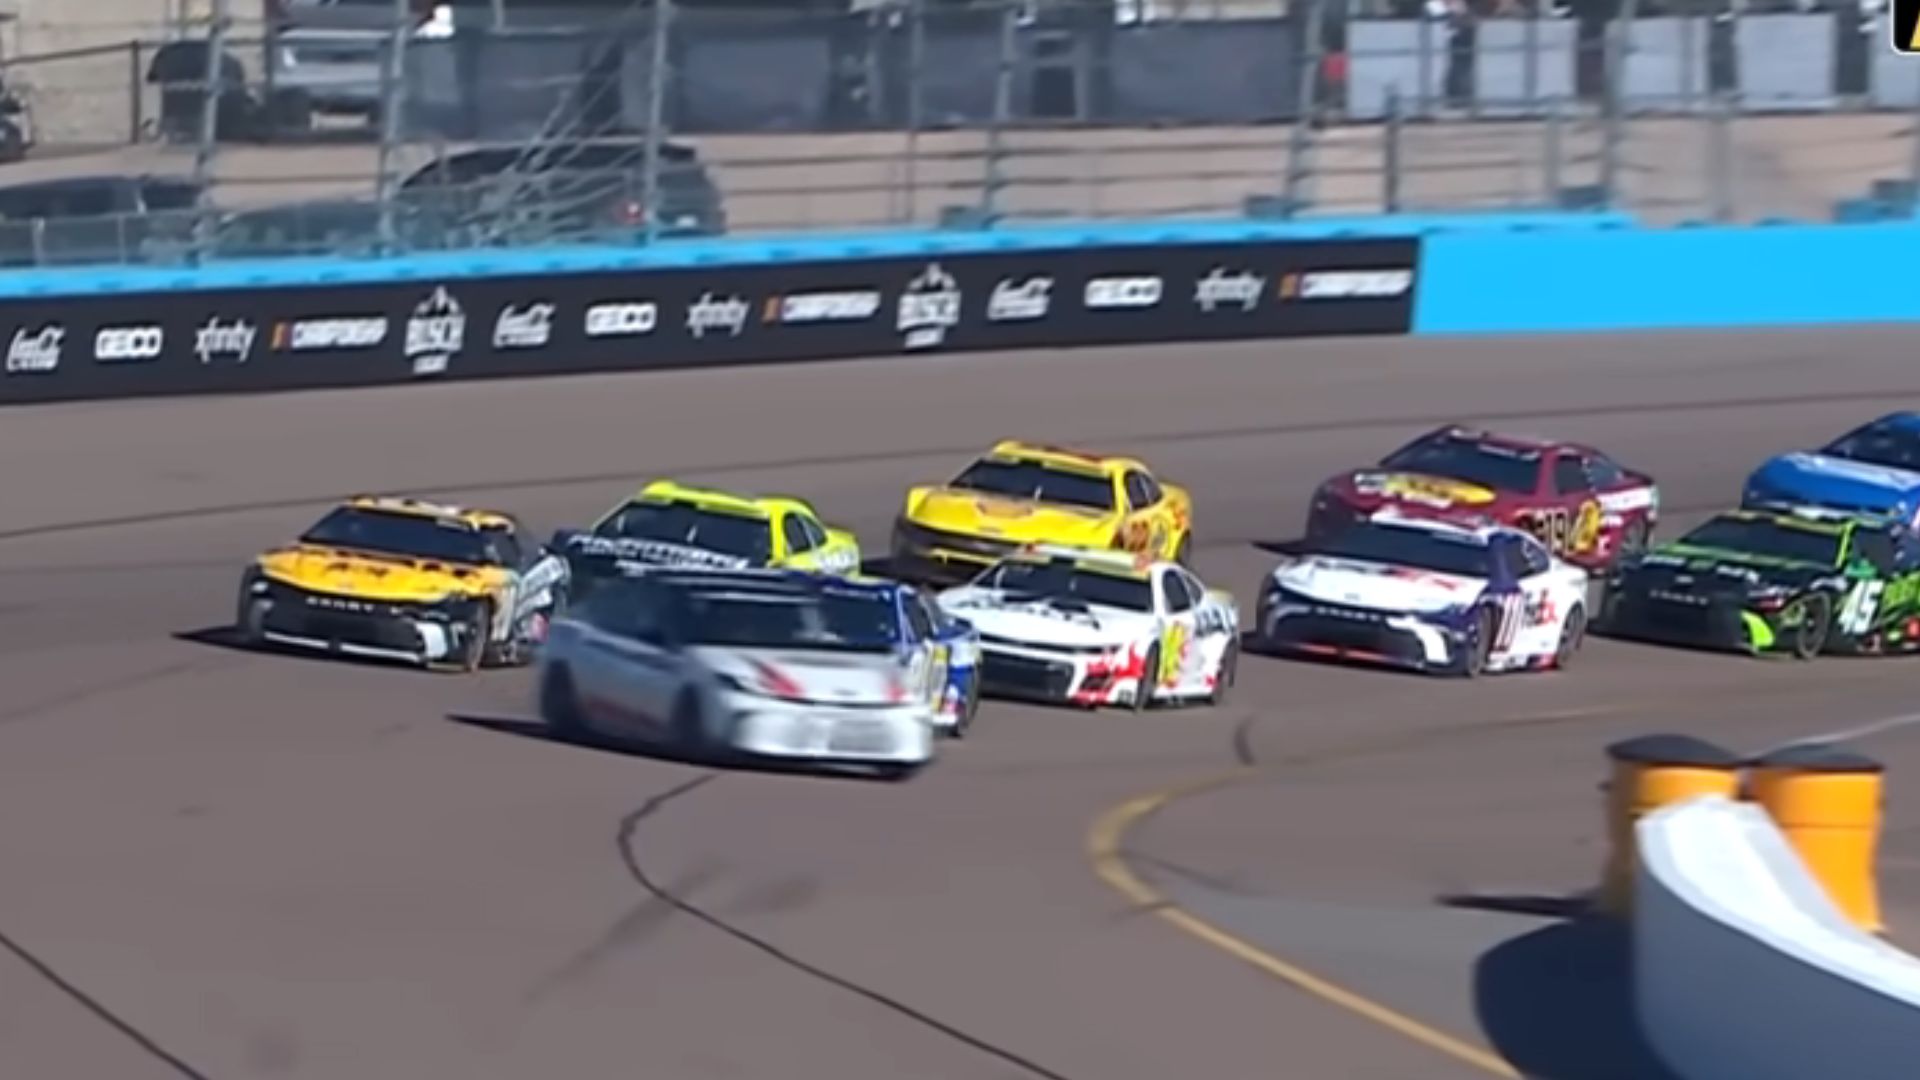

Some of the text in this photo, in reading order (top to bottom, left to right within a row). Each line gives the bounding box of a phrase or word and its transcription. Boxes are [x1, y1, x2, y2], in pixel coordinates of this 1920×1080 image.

[1085, 277, 1162, 306] GEICO
[585, 302, 656, 335] GEICO
[95, 326, 163, 359] GEICO
[1839, 580, 1884, 633] 45
